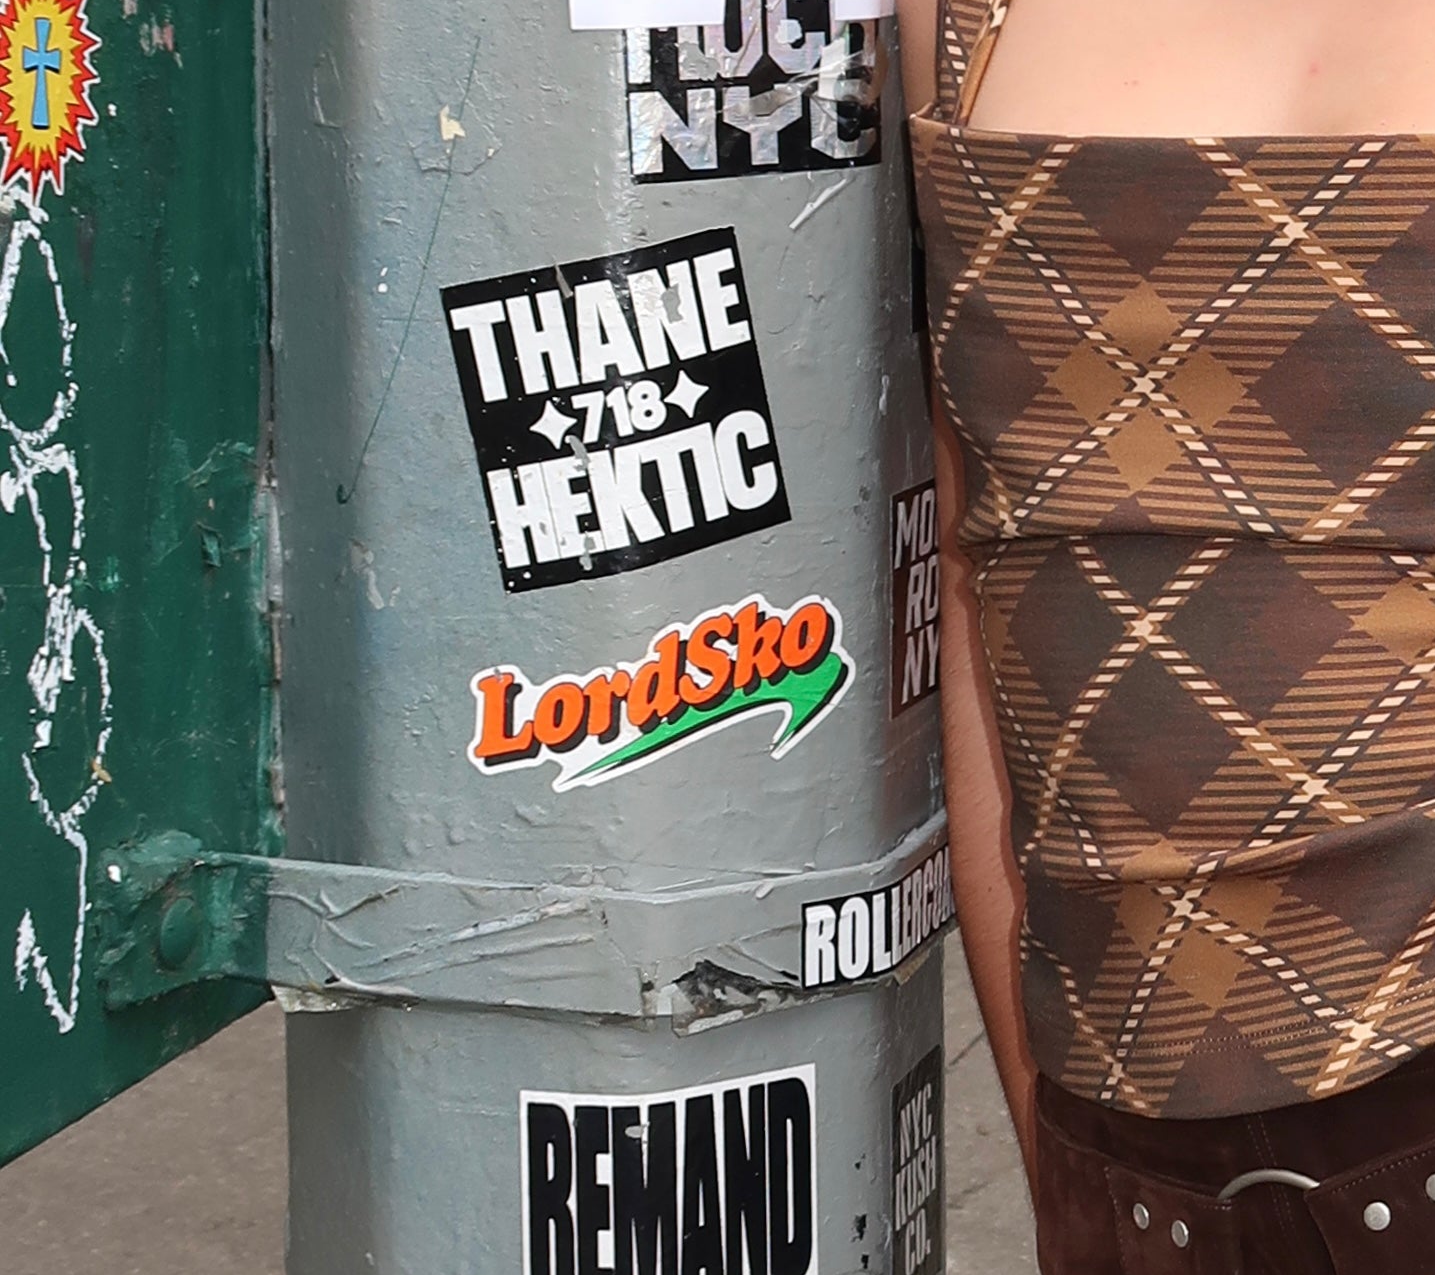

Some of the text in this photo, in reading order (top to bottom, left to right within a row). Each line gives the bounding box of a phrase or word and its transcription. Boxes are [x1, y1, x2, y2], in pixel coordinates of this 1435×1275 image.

[628, 84, 878, 175] NYC
[450, 248, 751, 403] THANE
[571, 379, 668, 445] 718
[486, 410, 778, 569] HEKTIC
[474, 601, 834, 765] LordSko
[900, 1082, 932, 1167] NYC
[895, 1135, 937, 1231] KUSH
